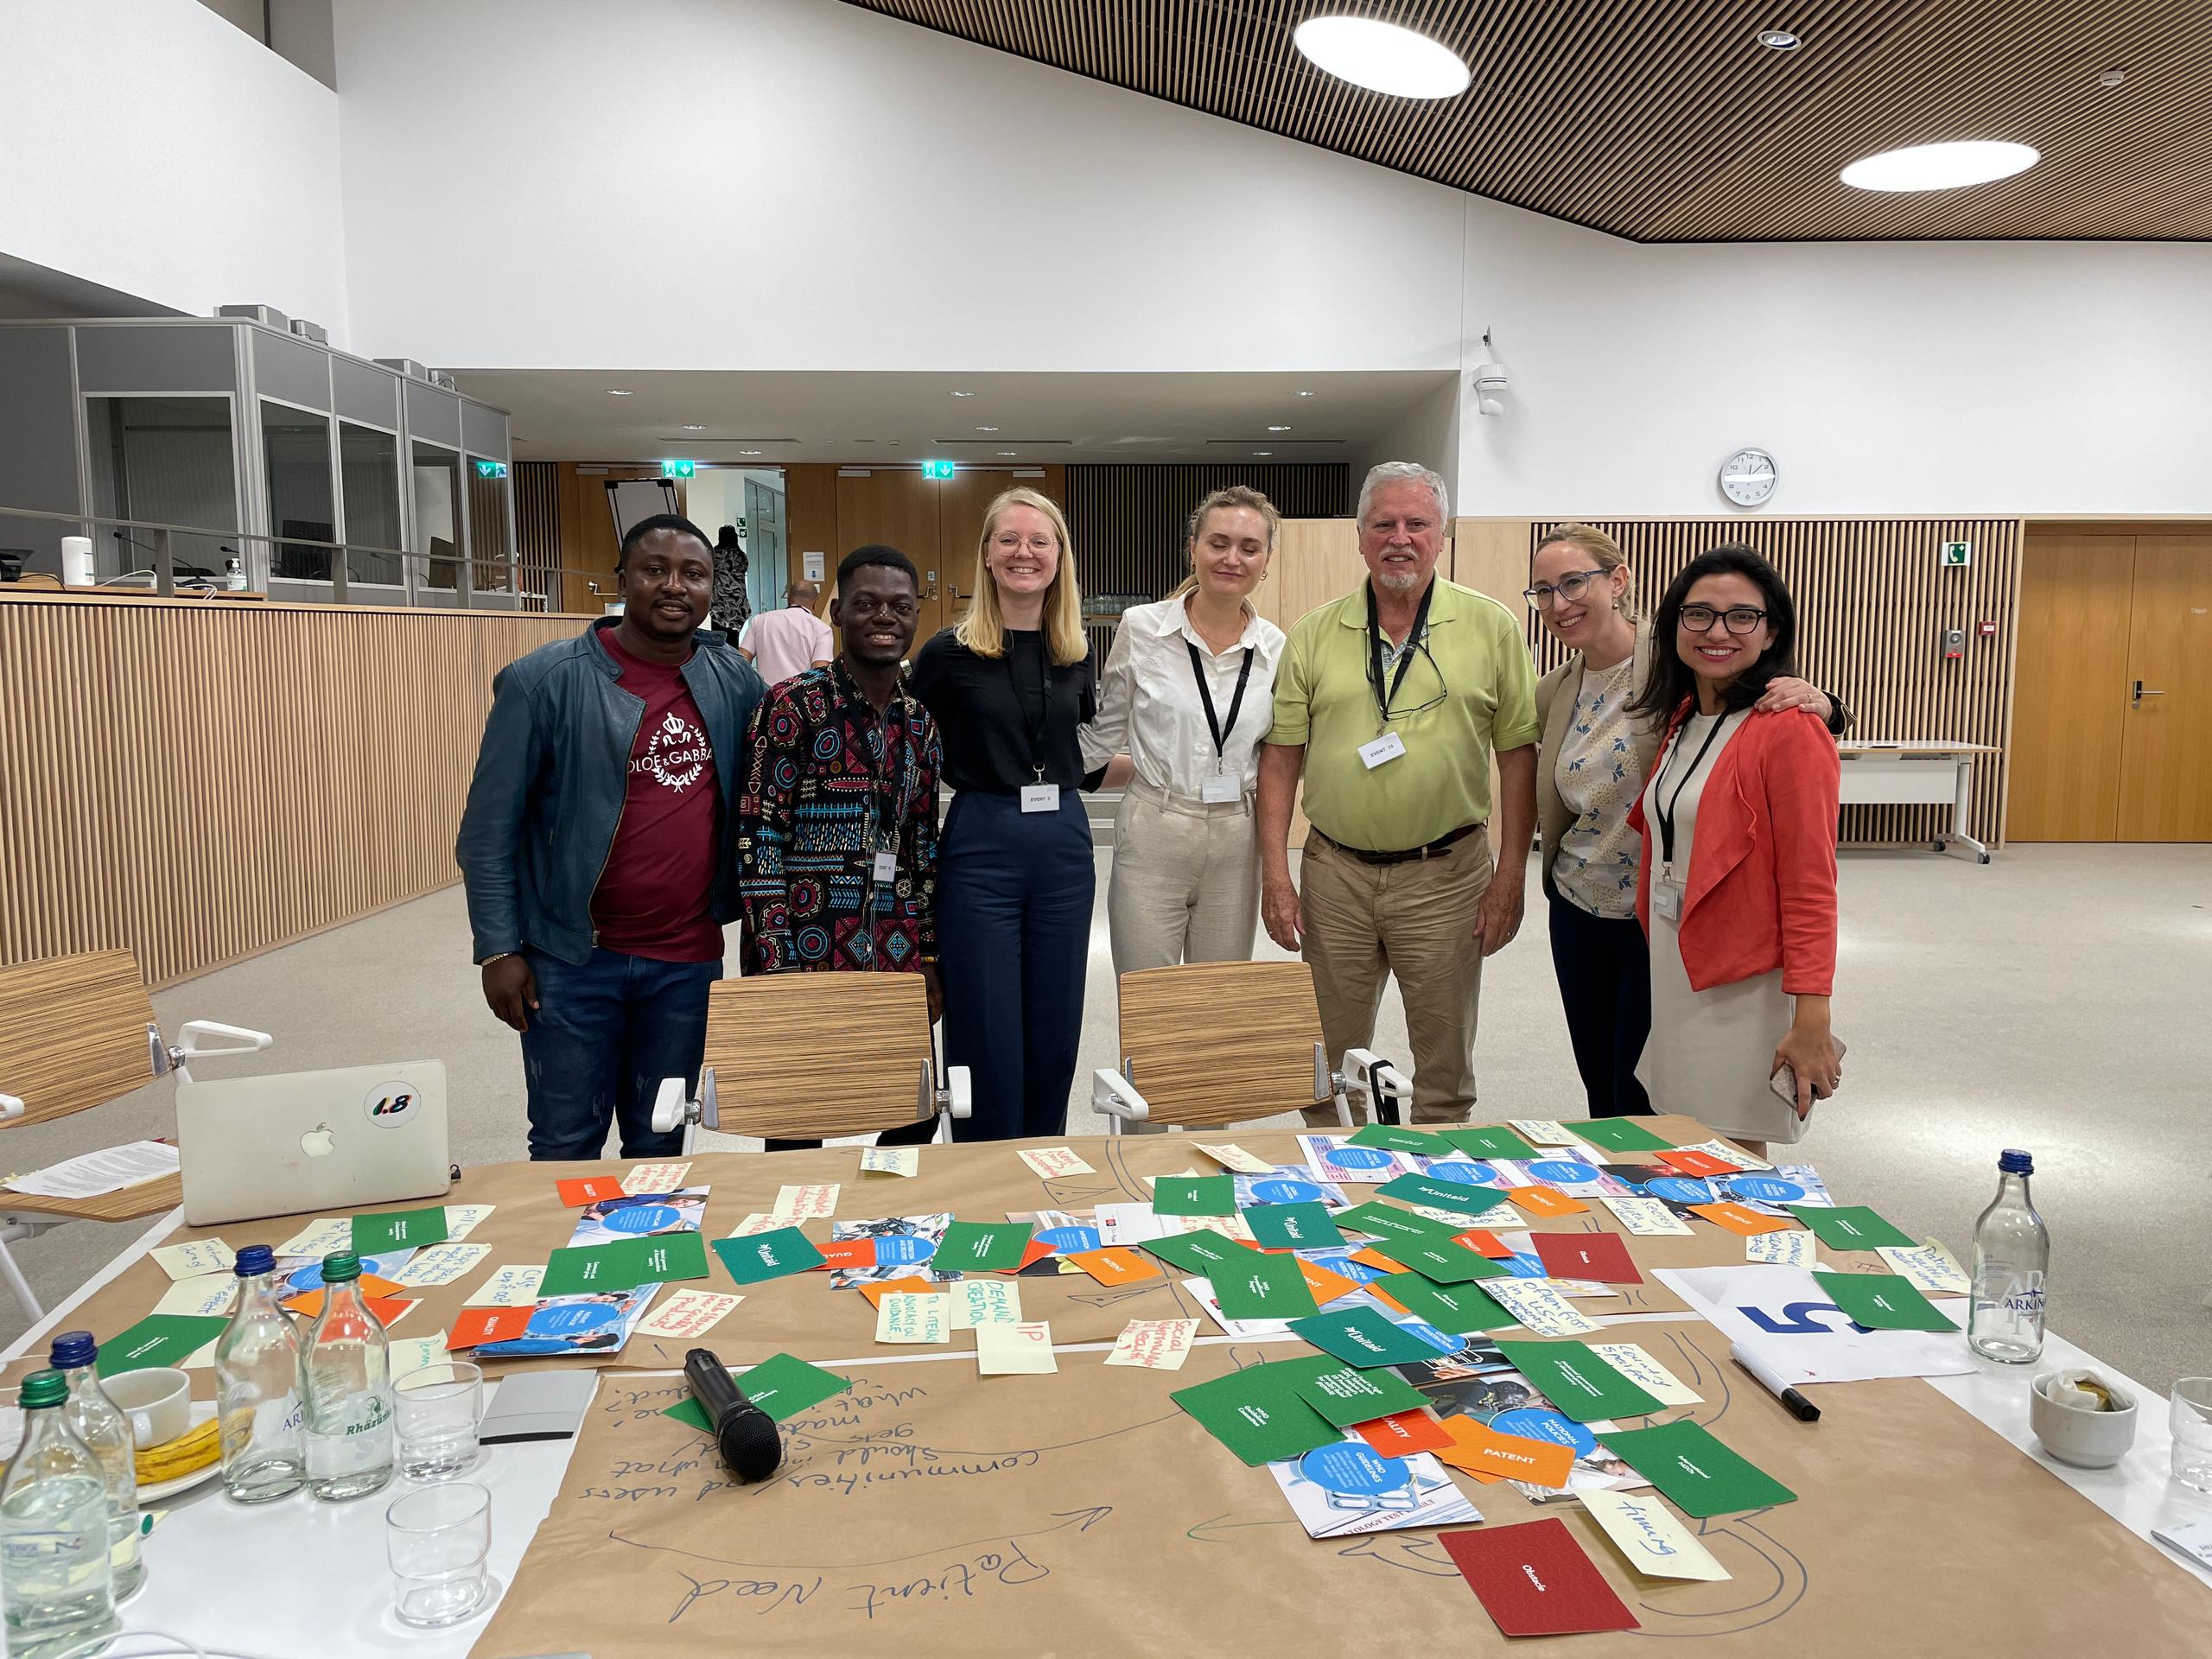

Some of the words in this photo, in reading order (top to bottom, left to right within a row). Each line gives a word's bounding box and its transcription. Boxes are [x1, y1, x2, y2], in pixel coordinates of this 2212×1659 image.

[1427, 1188, 1470, 1202] Unitaid
[1461, 1236, 1482, 1252] QUALITY
[1100, 1257, 1126, 1273] PATENT
[1508, 1283, 1522, 1294] in
[967, 1281, 987, 1325] CREATION
[483, 1316, 499, 1336] QUALITY
[1735, 1300, 1879, 1335] 5
[1016, 1325, 1045, 1342] IP
[1348, 1330, 1387, 1353] Unitaid
[836, 1386, 927, 1412] what
[1236, 1407, 1261, 1427] Committee
[1242, 1405, 1268, 1425] Guidelines
[1253, 1407, 1270, 1419] WHO
[849, 1422, 914, 1444] gets
[1383, 1417, 1411, 1439] ALITY
[1541, 1421, 1571, 1446] POLICIES
[1548, 1418, 1580, 1446] NATIONAL
[1371, 1459, 1387, 1474] WHO
[1484, 1447, 1536, 1465] PATENT
[1675, 1454, 1712, 1479] International
[610, 1459, 699, 1479] what
[1355, 1452, 1383, 1484] GUIDELINES
[578, 1485, 678, 1502] users
[1383, 1510, 1404, 1522] TEST
[1615, 1501, 1678, 1556] timing
[845, 1541, 1050, 1619] Patient
[1522, 1563, 1548, 1592] Obstacle
[667, 1570, 823, 1624] Need
